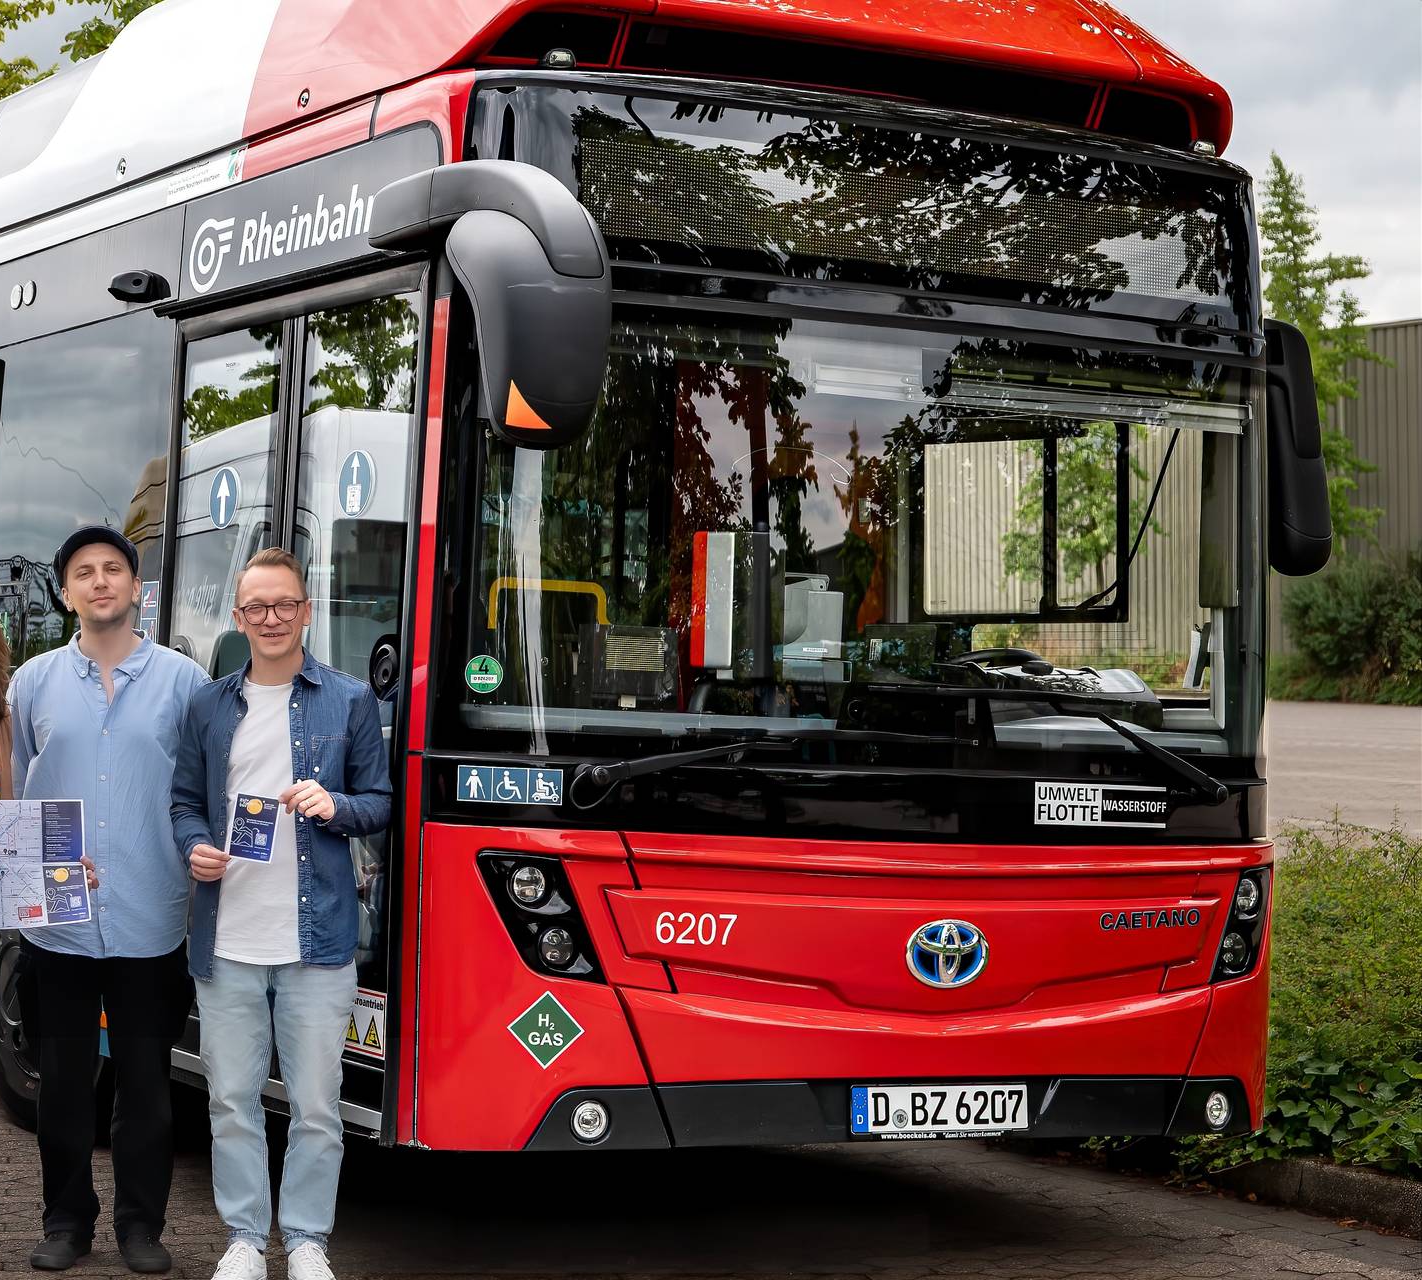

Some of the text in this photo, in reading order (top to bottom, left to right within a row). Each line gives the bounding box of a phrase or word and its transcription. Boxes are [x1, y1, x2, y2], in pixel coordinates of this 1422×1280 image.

[478, 658, 490, 675] 4
[1037, 786, 1099, 803] UMWELT
[1037, 804, 1099, 822] FLOTTE
[1102, 799, 1167, 813] WASSERSTOFF
[1099, 908, 1200, 931] CAETANO
[655, 911, 738, 946] 6207
[527, 1031, 564, 1047] GAS
[872, 1090, 1024, 1127] D BZ 6207
[856, 1114, 864, 1125] D
